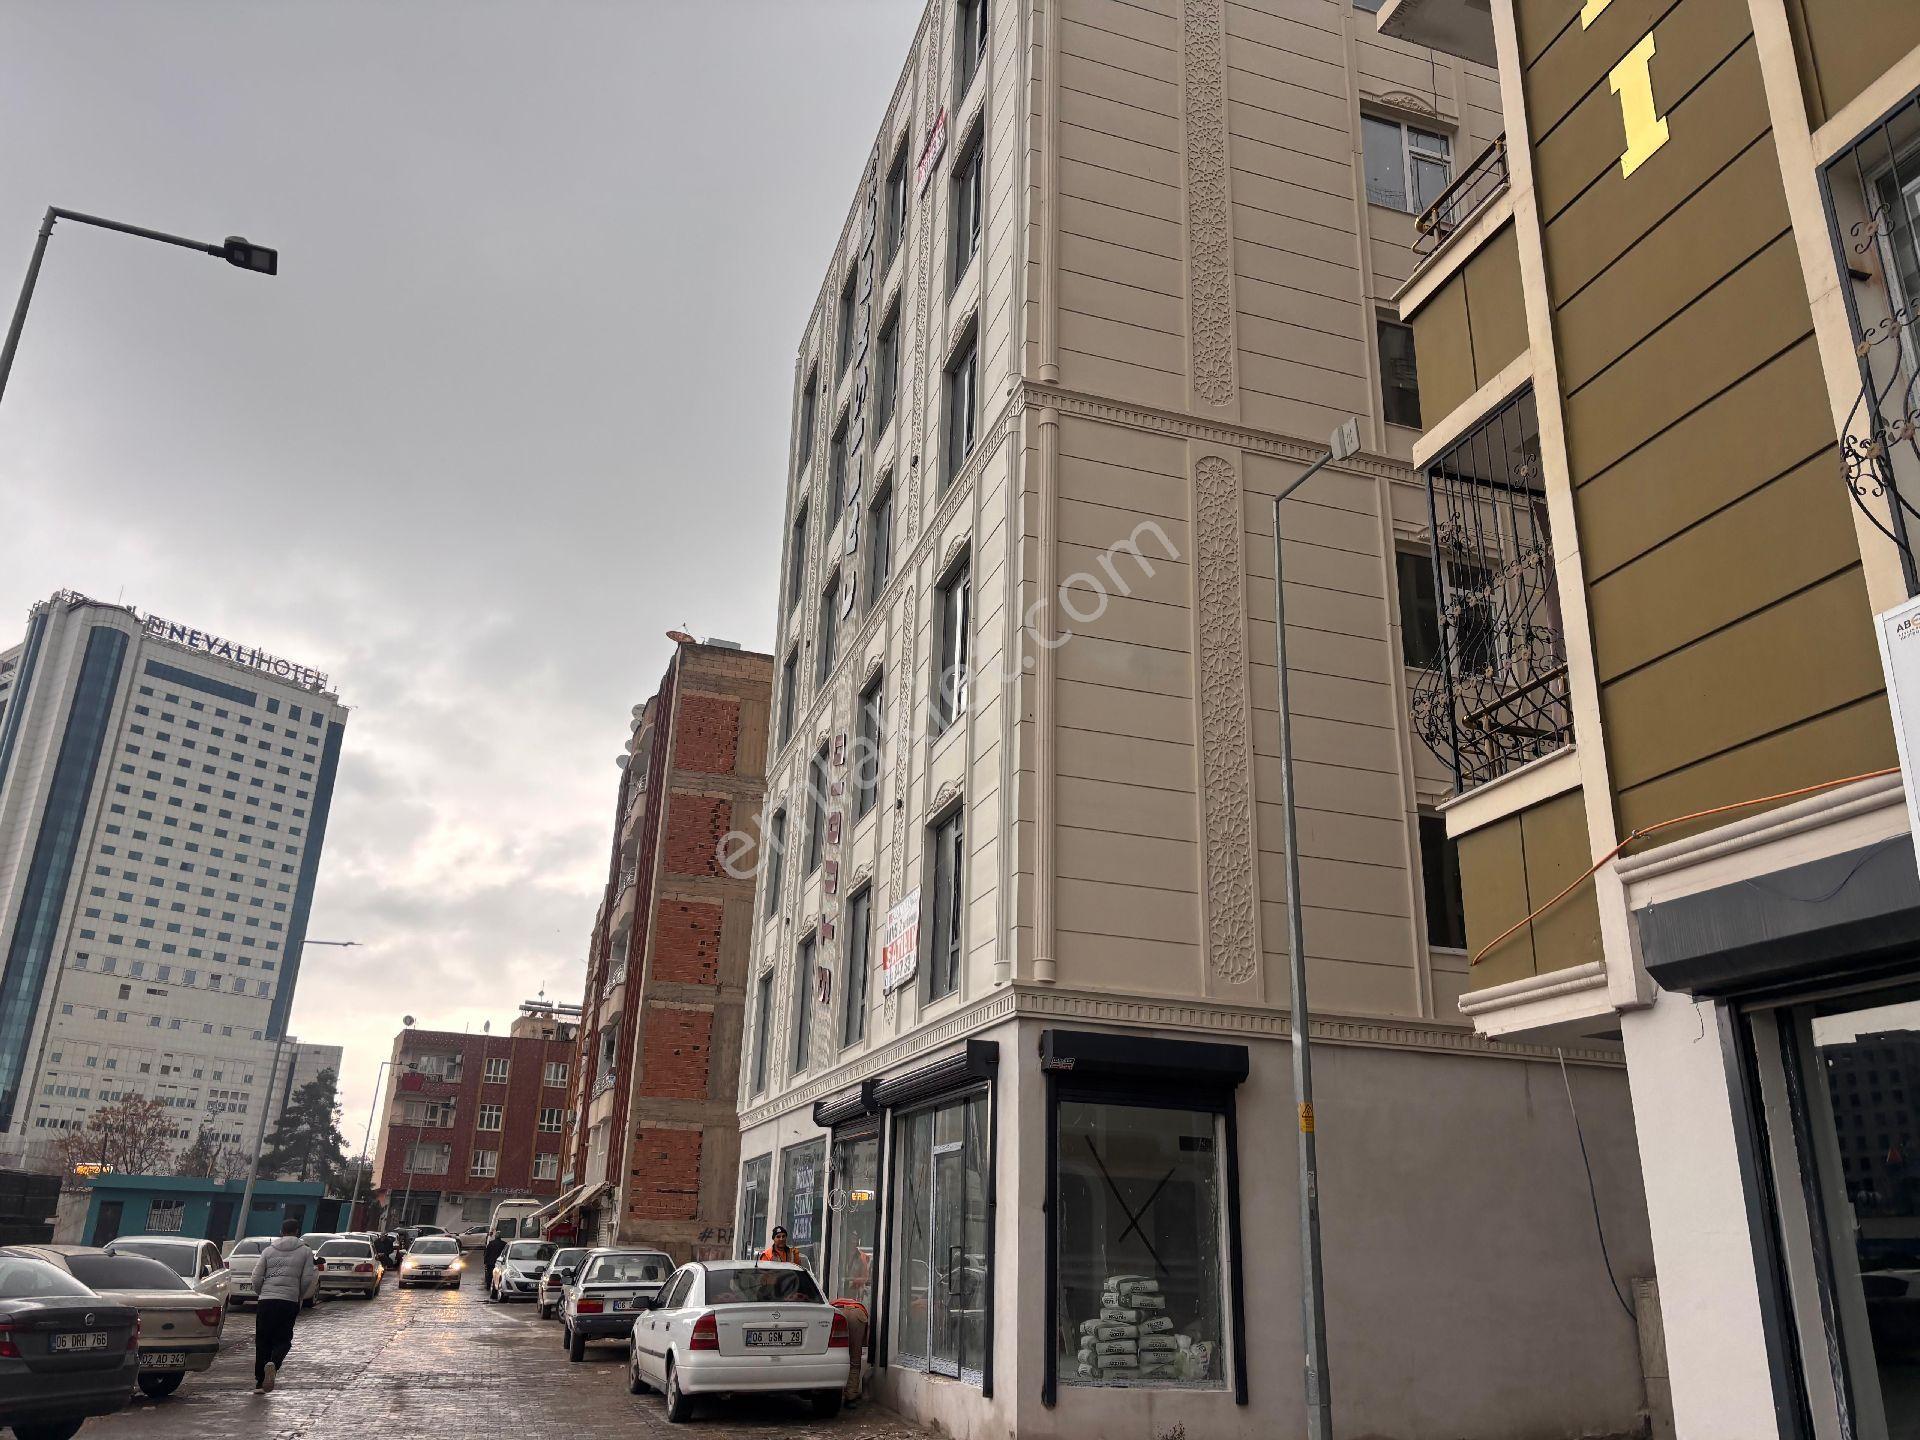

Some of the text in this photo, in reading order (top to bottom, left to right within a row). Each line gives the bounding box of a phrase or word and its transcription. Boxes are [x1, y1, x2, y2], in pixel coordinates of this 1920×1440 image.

[56, 1334, 106, 1348] 06 DRH 766
[752, 1332, 763, 1342] 06
[791, 1331, 800, 1342] 29
[142, 1354, 152, 1364] 02
